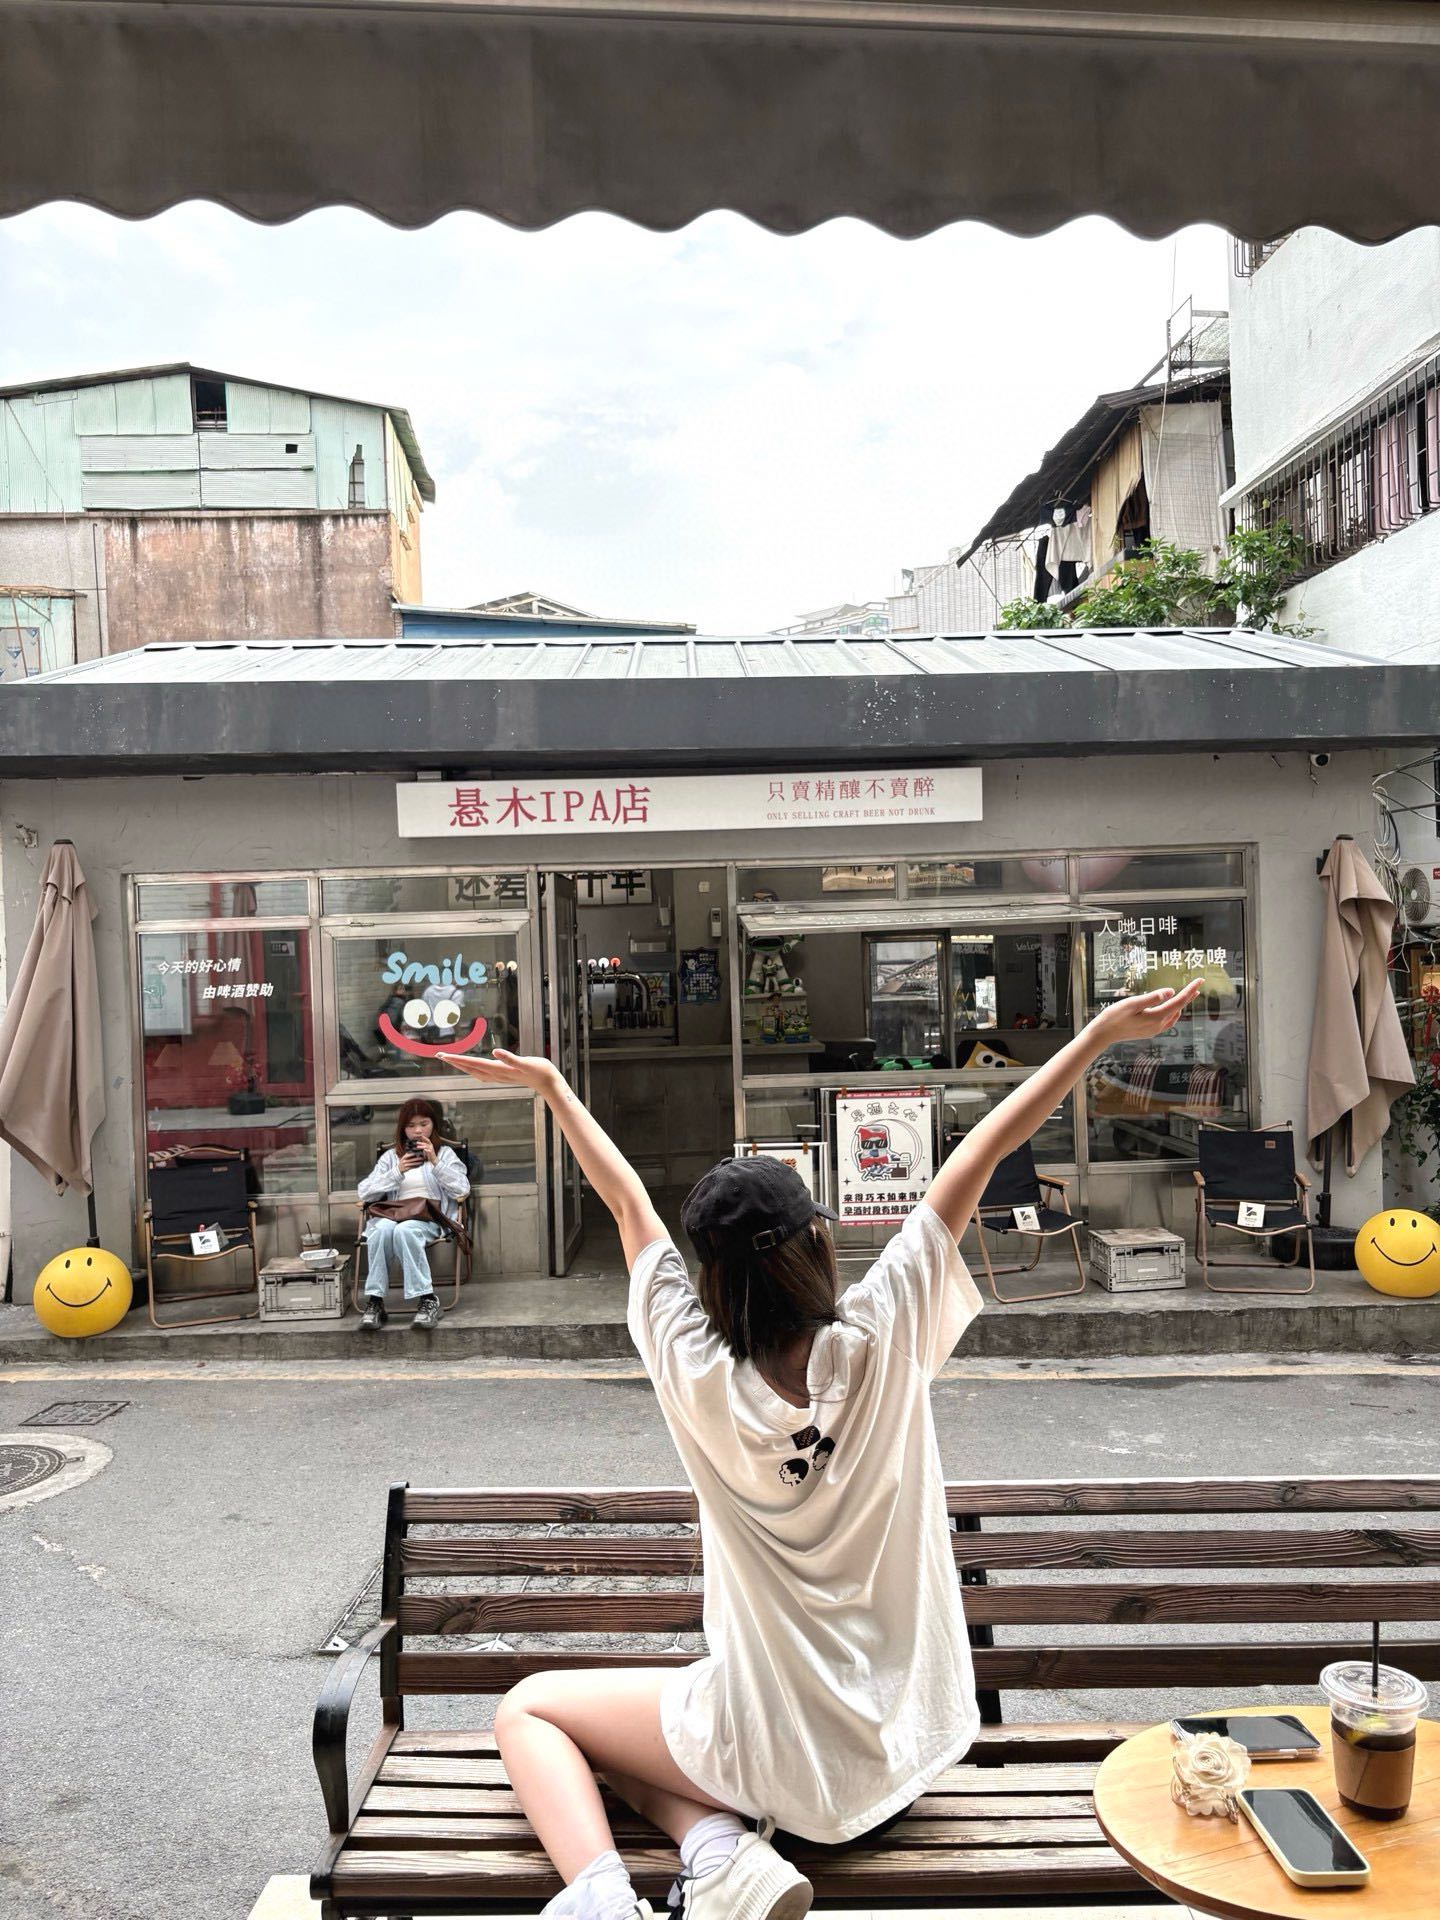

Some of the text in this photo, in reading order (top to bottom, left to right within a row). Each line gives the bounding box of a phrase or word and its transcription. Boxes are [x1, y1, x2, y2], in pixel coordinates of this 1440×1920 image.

[767, 776, 935, 801] 只賣精釀不賣醉
[448, 784, 650, 827] 悬木IPA店
[766, 807, 936, 821] ONLY SELLING CRAFT BEER NOT DRUNK
[157, 957, 242, 975] 今天的好心情
[382, 951, 488, 986] Smile
[202, 982, 274, 999] 由啤酒赞助
